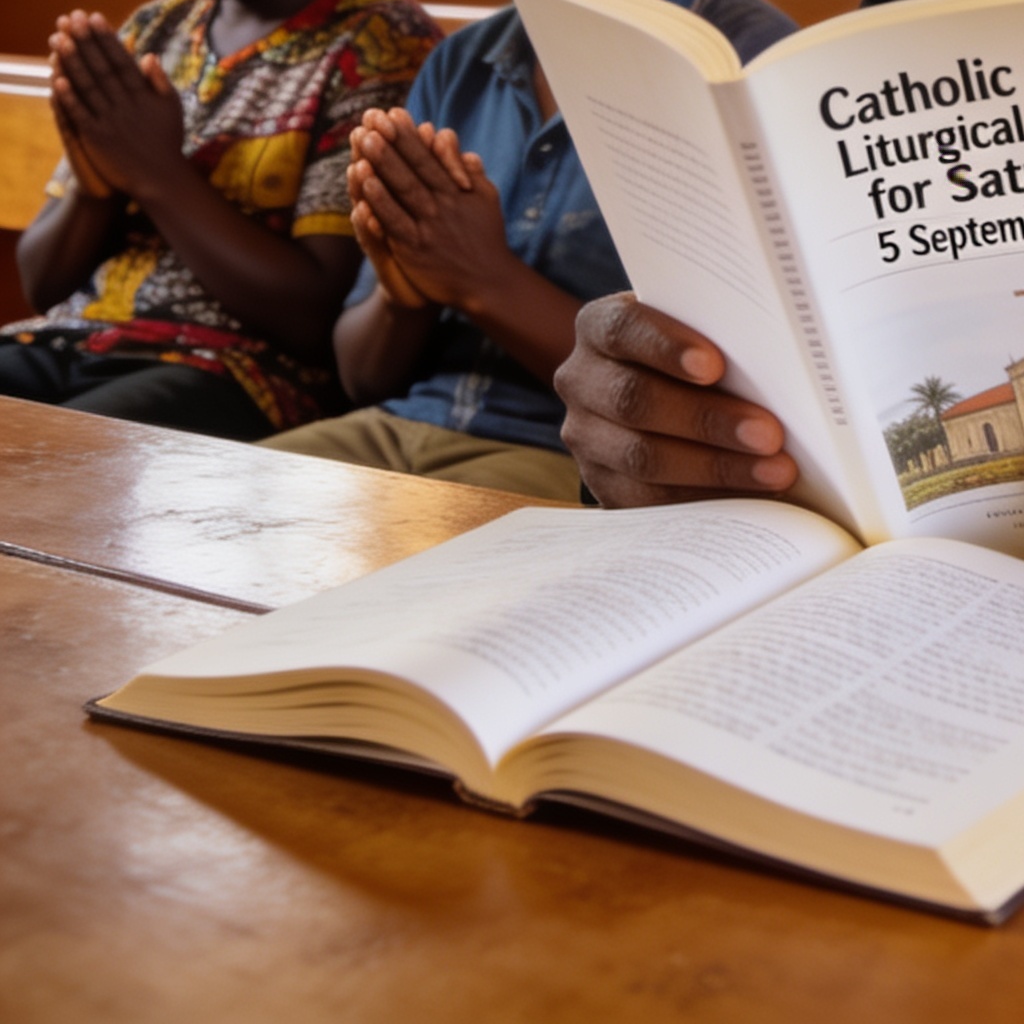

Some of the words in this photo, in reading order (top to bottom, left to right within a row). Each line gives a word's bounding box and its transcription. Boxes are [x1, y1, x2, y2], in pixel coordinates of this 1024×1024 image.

[819, 58, 1017, 131] Catholic
[867, 177, 932, 219] for
[877, 229, 901, 263] 5
